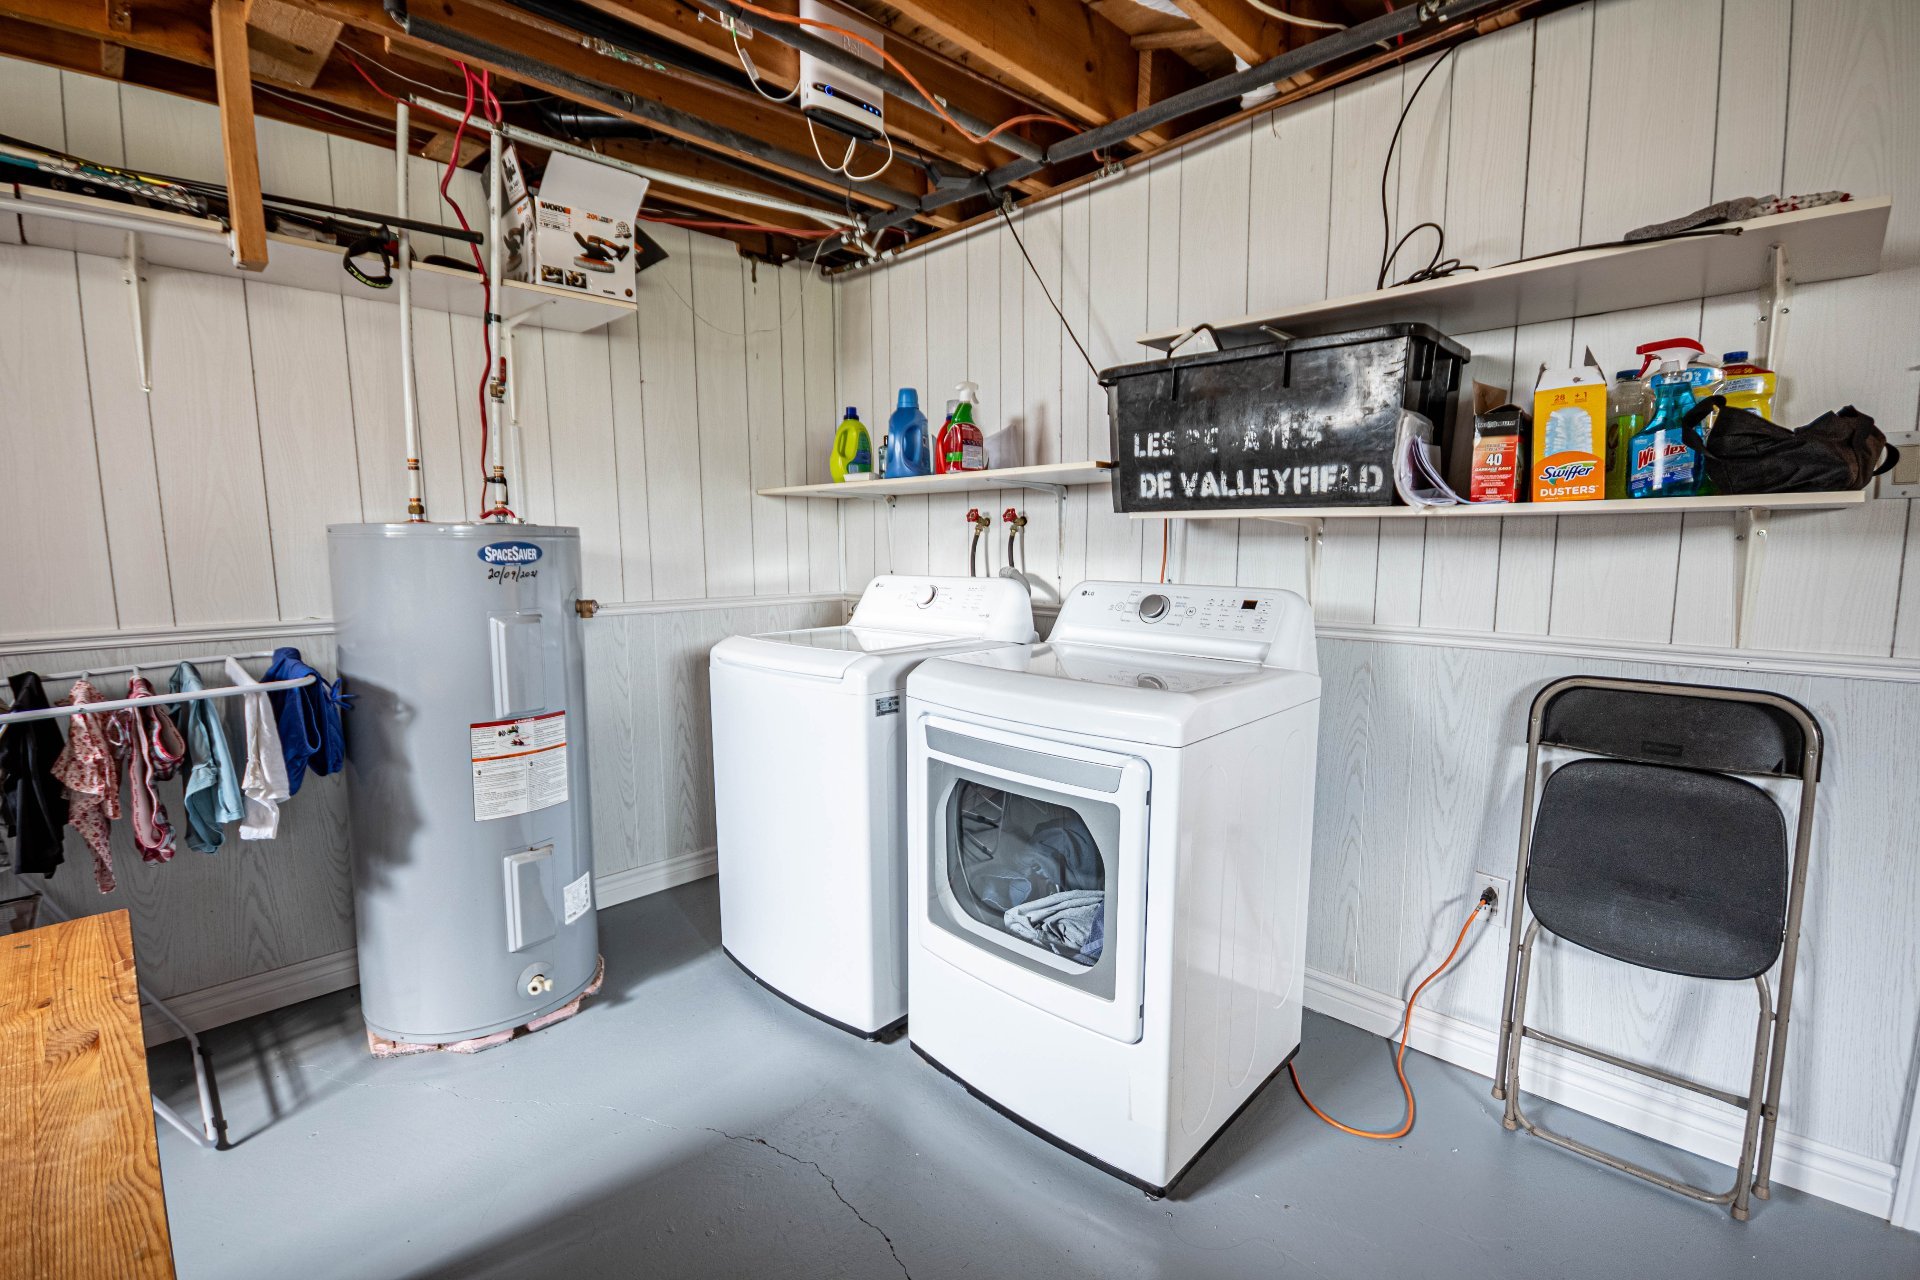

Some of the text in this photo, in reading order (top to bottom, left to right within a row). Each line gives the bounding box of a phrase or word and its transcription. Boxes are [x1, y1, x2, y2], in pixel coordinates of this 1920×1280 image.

[1133, 431, 1176, 458] LES
[1486, 453, 1503, 466] 40
[1140, 464, 1384, 498] DE VALLEYFIELD
[1539, 465, 1594, 482] Swiffer
[1540, 485, 1597, 497] DUSTERS
[484, 546, 538, 562] SPACESAVER
